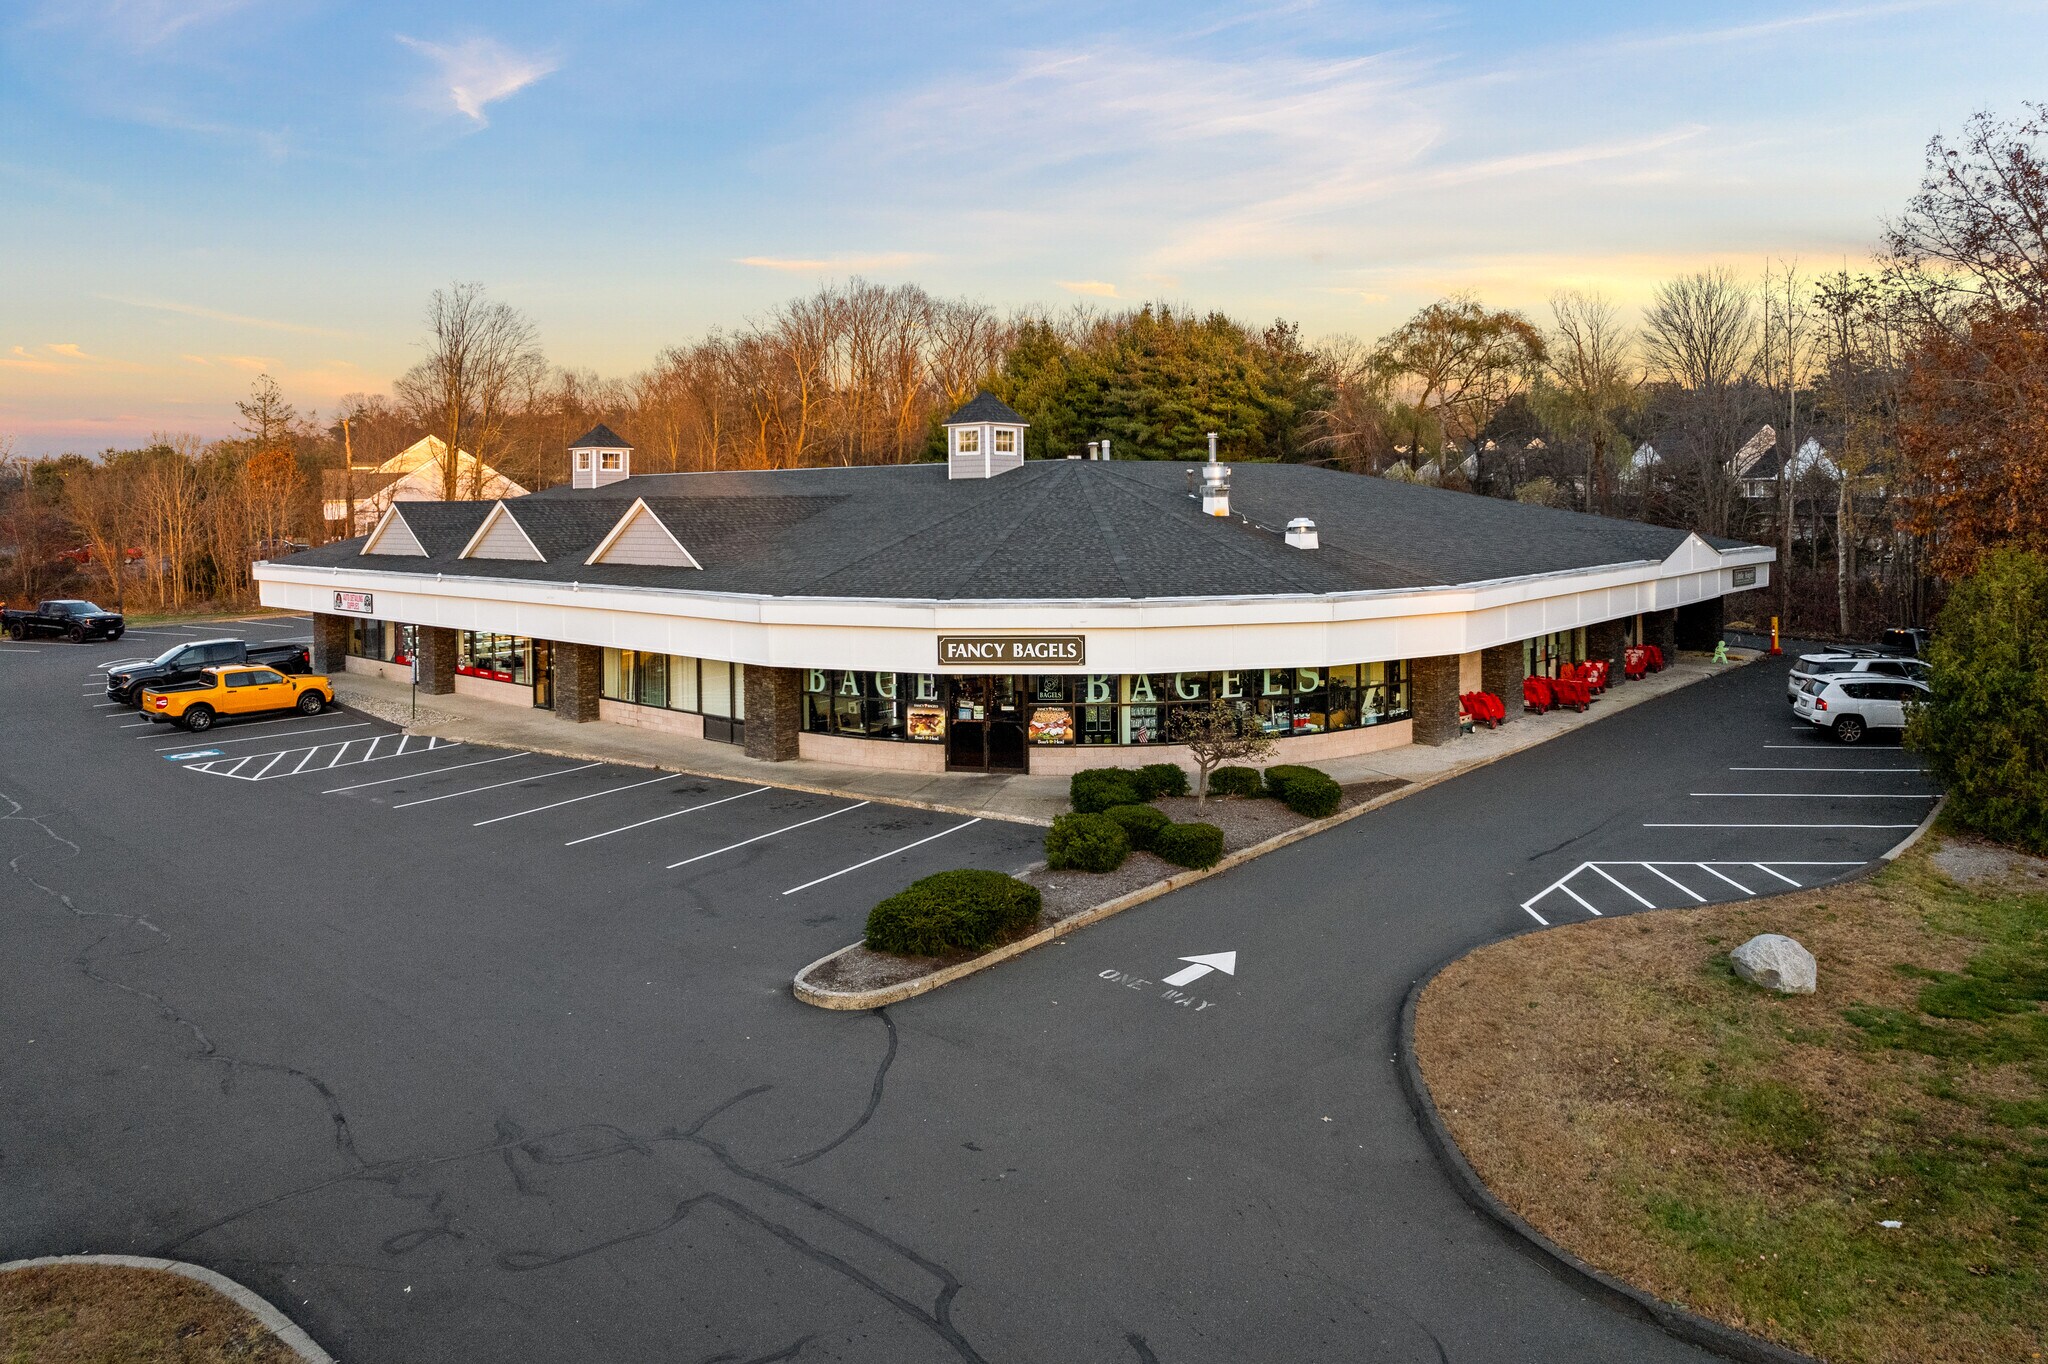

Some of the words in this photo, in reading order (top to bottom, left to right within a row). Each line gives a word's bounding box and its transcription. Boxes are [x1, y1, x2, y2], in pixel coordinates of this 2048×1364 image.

[947, 642, 1006, 658] FANCY
[1013, 642, 1077, 658] BAGELS
[1039, 691, 1062, 699] BAGELS
[1086, 668, 1320, 703] BAGELS
[1098, 969, 1152, 991] ONE
